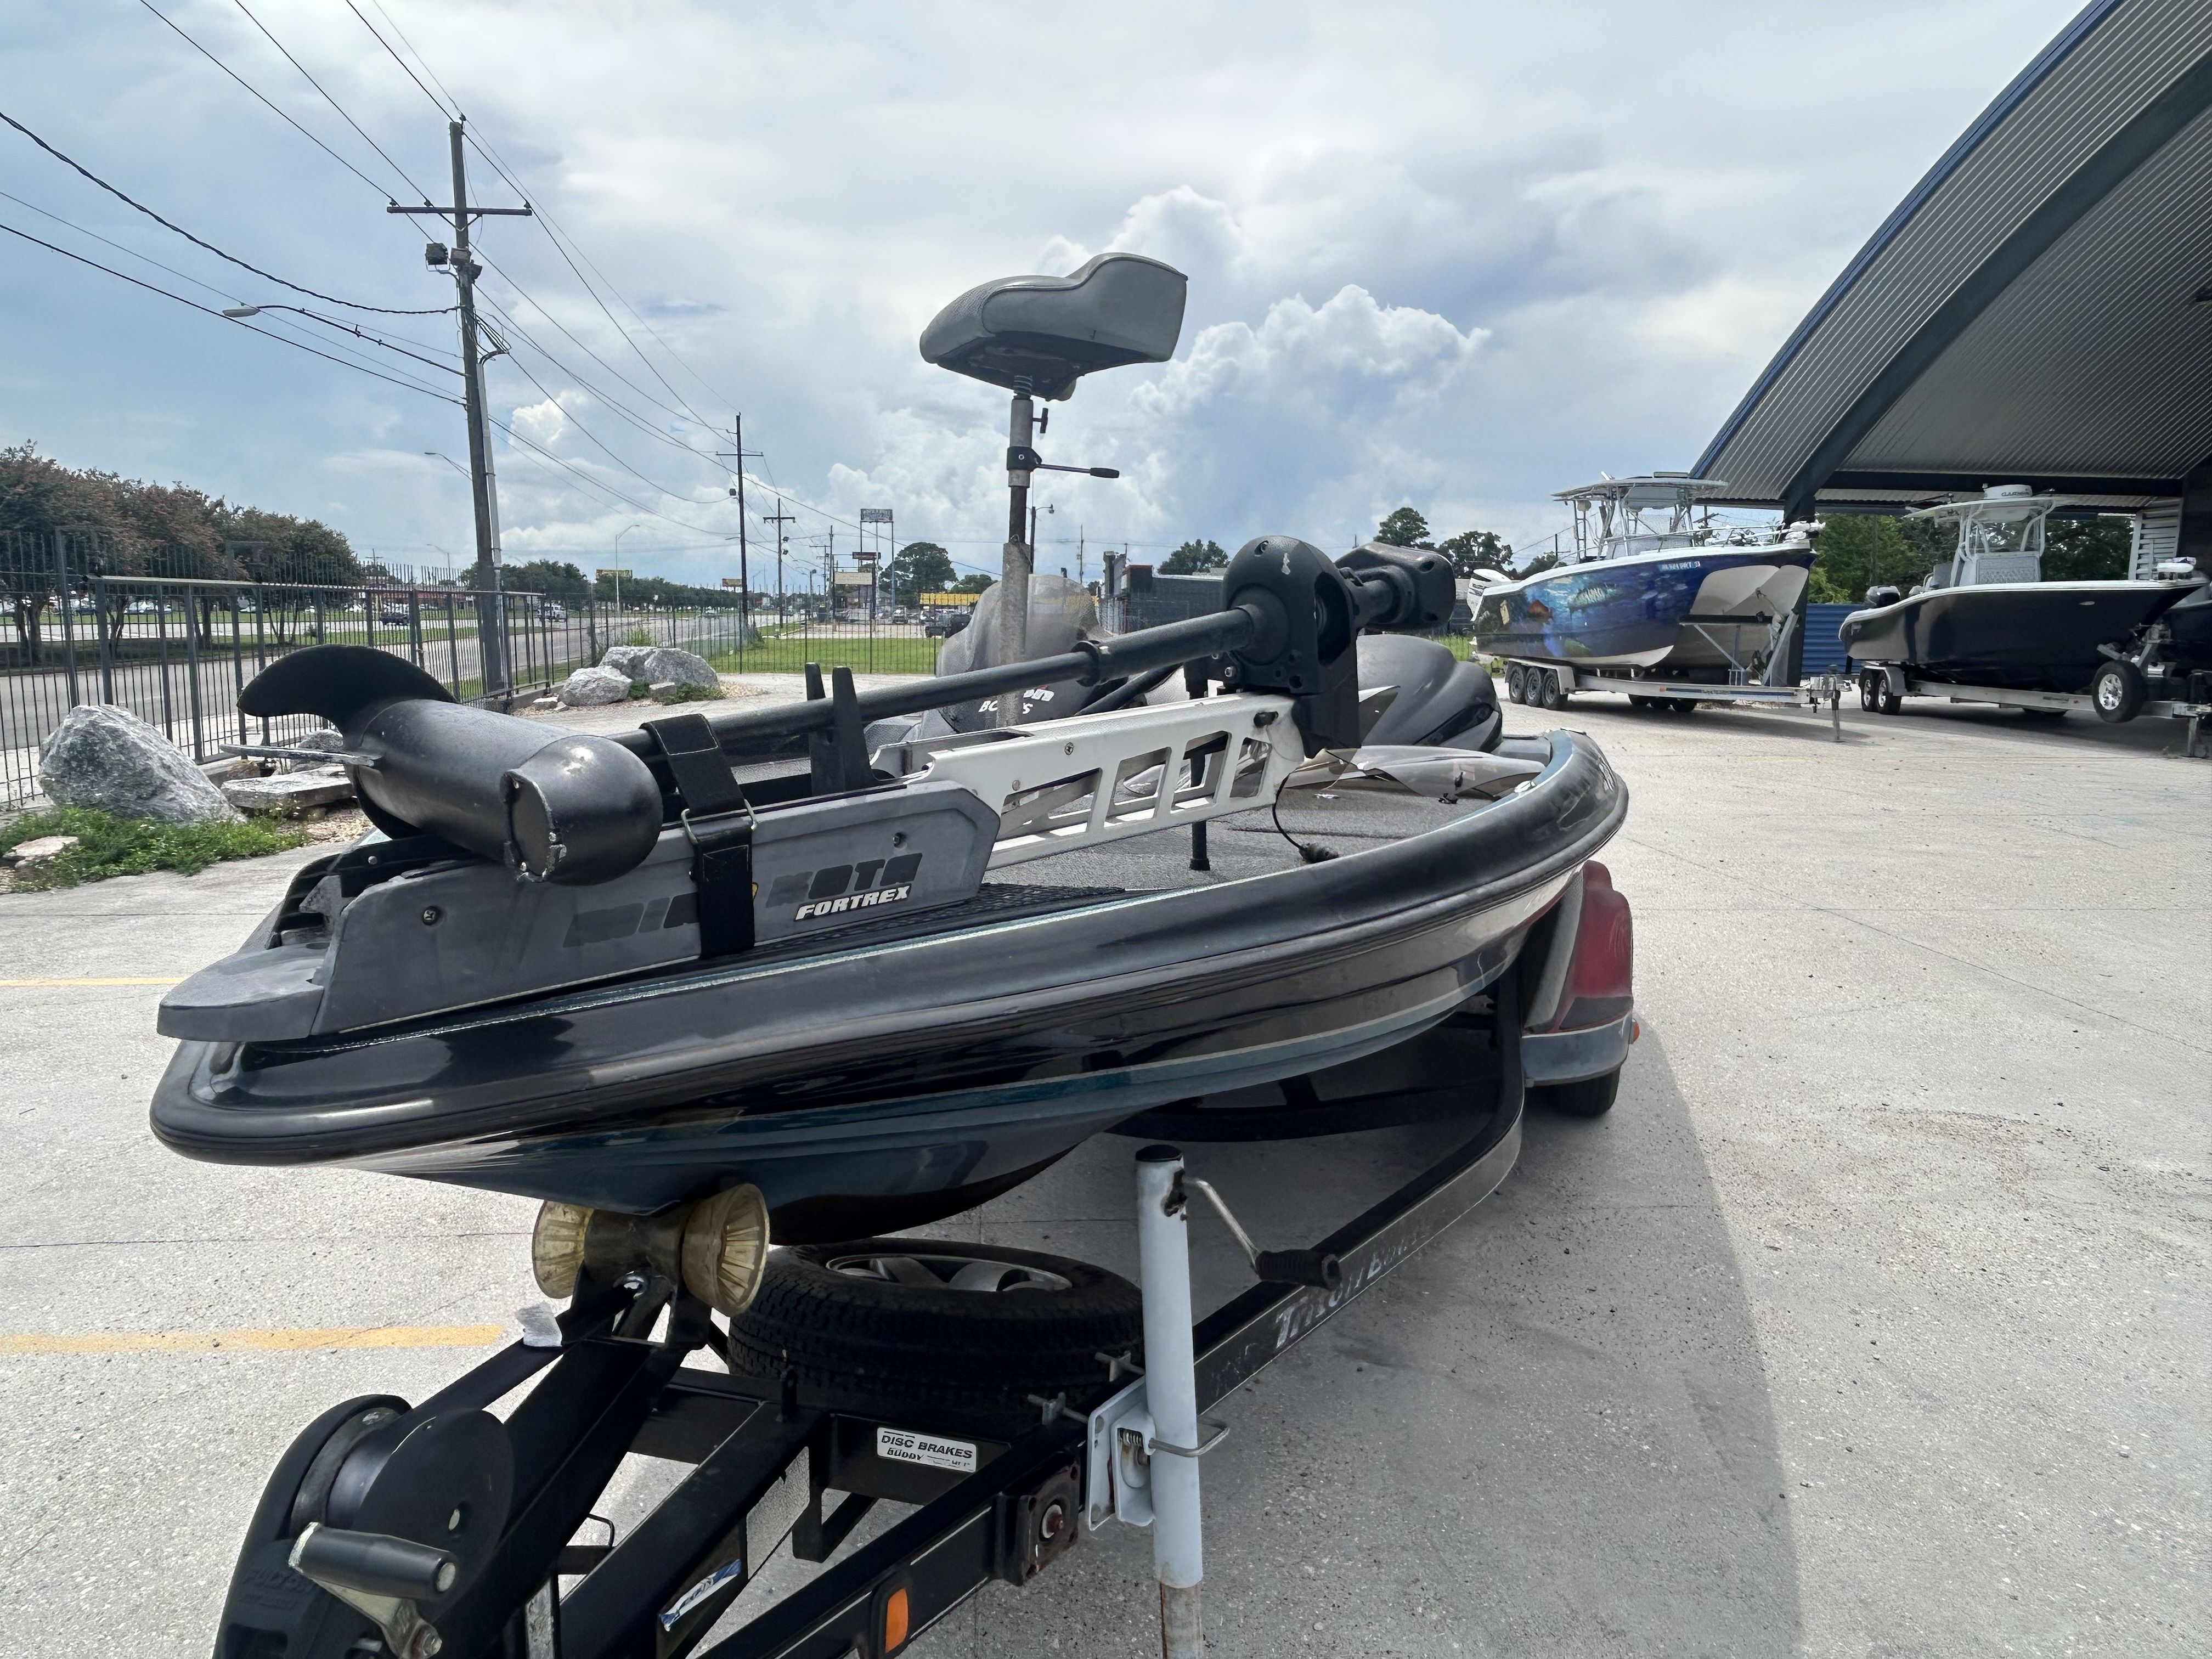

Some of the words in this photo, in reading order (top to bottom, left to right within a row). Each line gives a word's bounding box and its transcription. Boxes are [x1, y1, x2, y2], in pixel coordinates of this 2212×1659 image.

[795, 885, 910, 921] FORTREX
[881, 1435, 915, 1448] DISC
[918, 1442, 973, 1459] BRAKES
